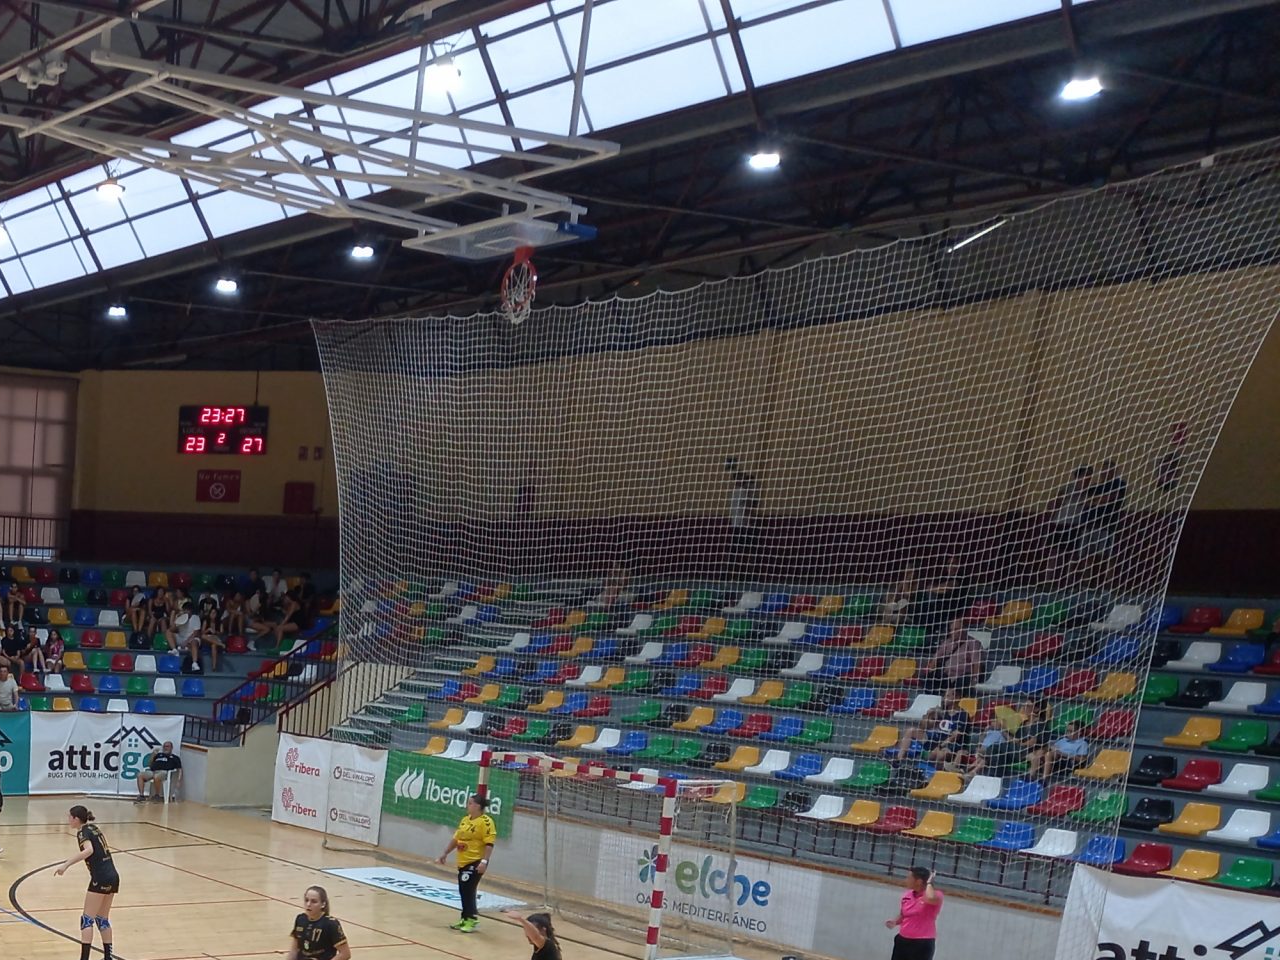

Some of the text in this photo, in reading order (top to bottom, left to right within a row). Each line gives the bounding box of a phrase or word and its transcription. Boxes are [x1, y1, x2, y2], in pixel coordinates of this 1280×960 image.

[201, 408, 245, 422] 23:27
[186, 433, 263, 452] 23 2 27
[295, 762, 320, 777] ribera
[291, 803, 317, 818] ribera
[675, 855, 771, 906] elche
[636, 892, 767, 933] OAS MEDITERRÁNEO
[311, 928, 322, 942] 17
